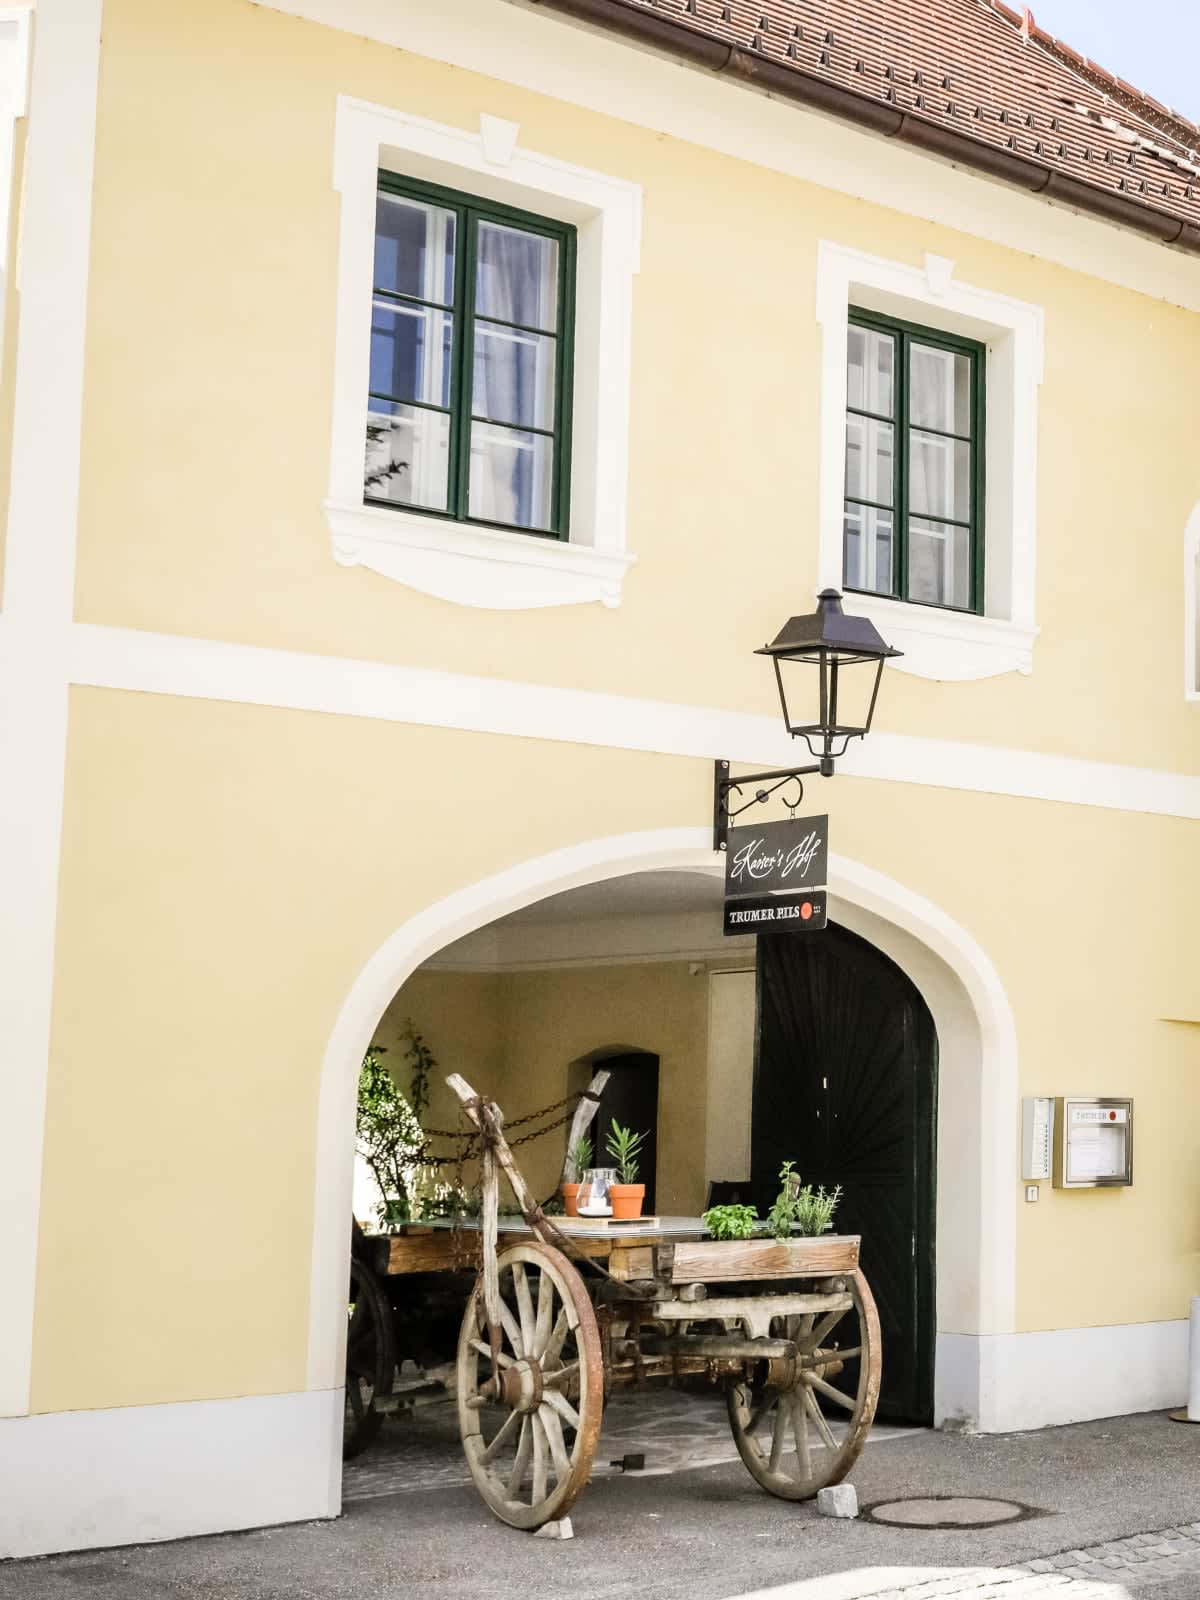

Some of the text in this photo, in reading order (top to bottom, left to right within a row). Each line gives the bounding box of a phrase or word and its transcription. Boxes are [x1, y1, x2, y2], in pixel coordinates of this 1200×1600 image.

[730, 831, 822, 880] Kaiser's Hof
[729, 908, 775, 923] TRUMER
[776, 905, 800, 920] PILS
